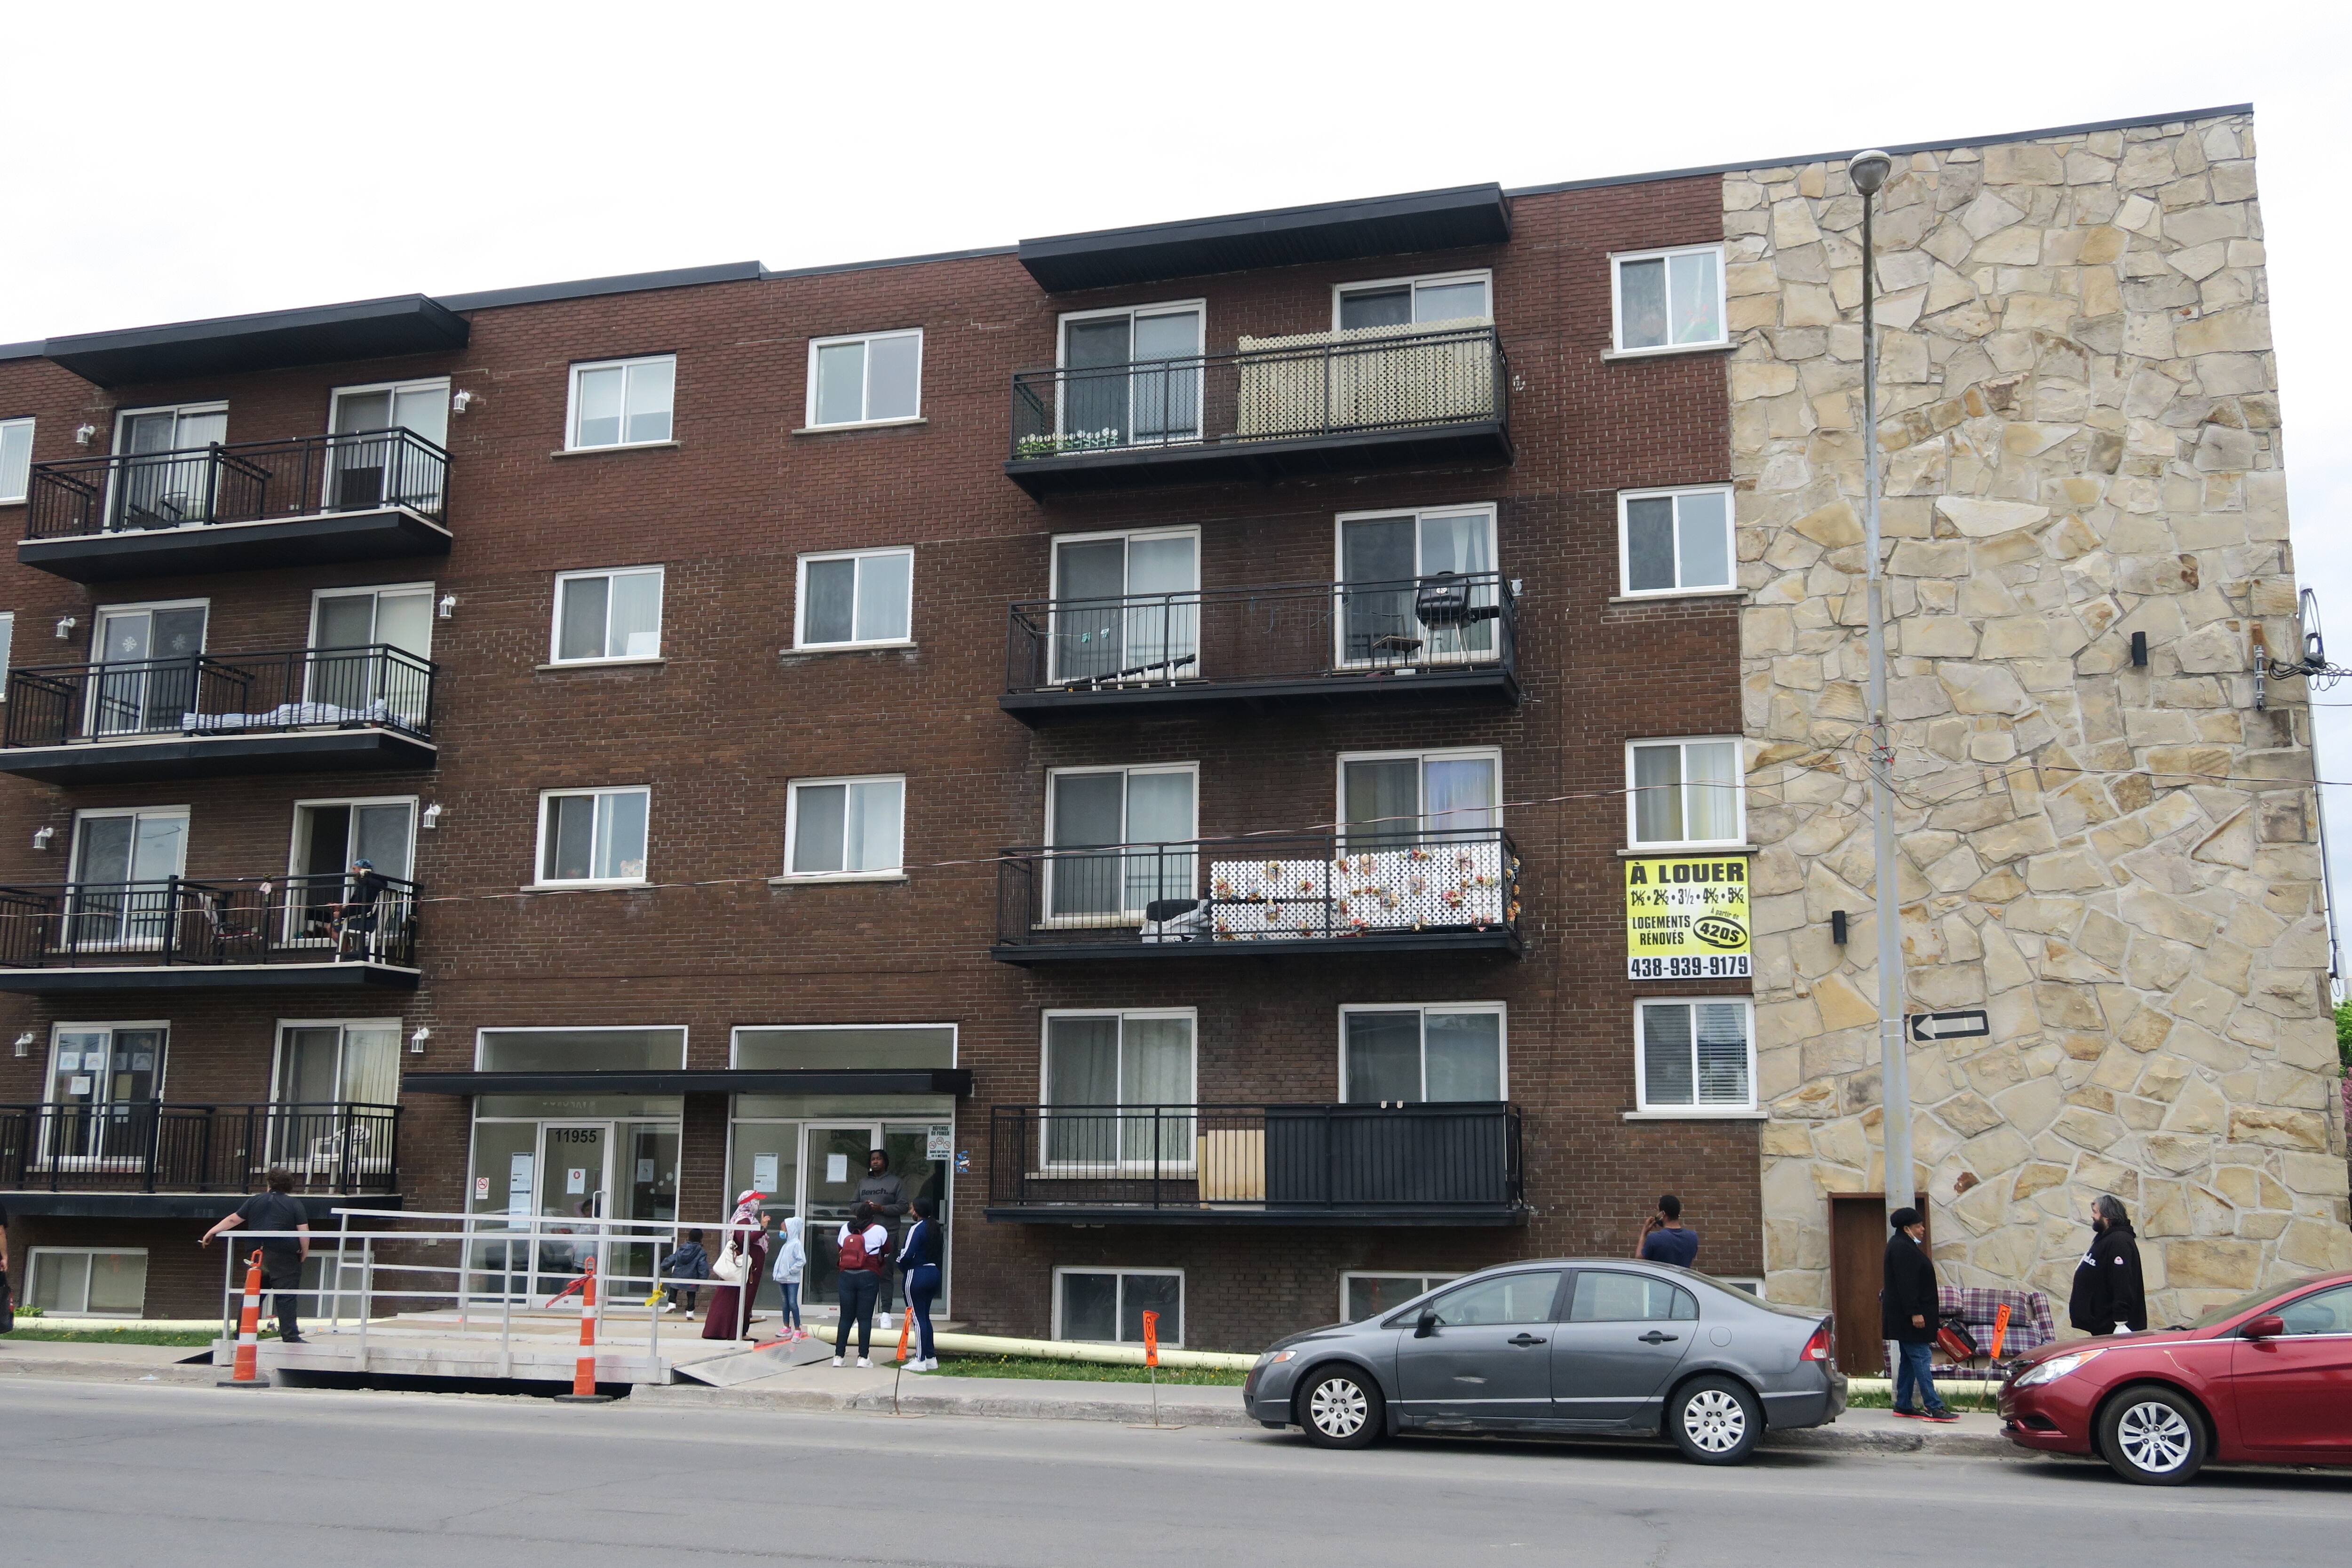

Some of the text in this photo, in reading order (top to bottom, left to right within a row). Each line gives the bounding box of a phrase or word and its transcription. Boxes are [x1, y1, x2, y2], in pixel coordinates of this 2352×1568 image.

[1630, 862, 1744, 884] À LOUER
[1632, 915, 1691, 930] LOGEMENTS
[1640, 930, 1685, 946] RÉNOVÉS
[1700, 922, 1740, 943] 420$
[1631, 956, 1748, 977] 438-939-9179
[556, 1130, 596, 1143] 11955
